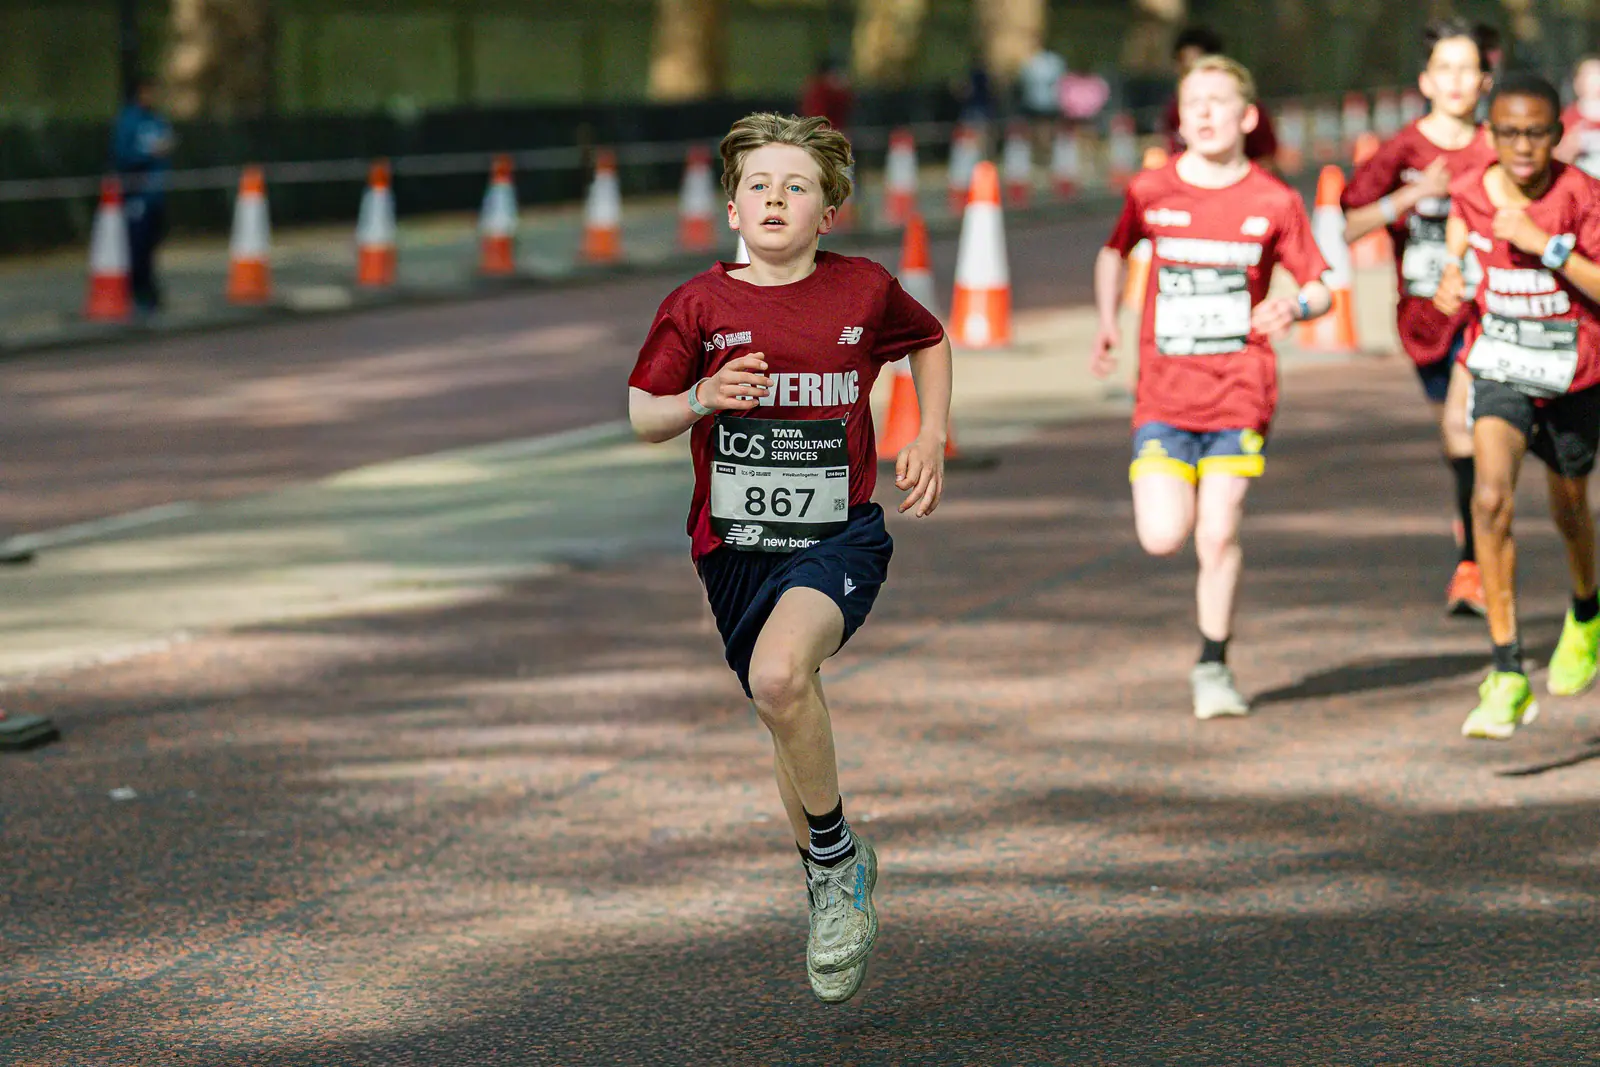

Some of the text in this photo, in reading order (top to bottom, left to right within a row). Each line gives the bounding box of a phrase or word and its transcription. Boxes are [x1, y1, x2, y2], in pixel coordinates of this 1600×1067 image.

[736, 369, 860, 407] VERING
[771, 428, 803, 439] TATA
[719, 424, 765, 460] tcs
[771, 438, 843, 450] CONSULTANCY
[771, 451, 819, 461] SERVICES
[744, 486, 816, 518] 867
[763, 537, 821, 549] new bala
